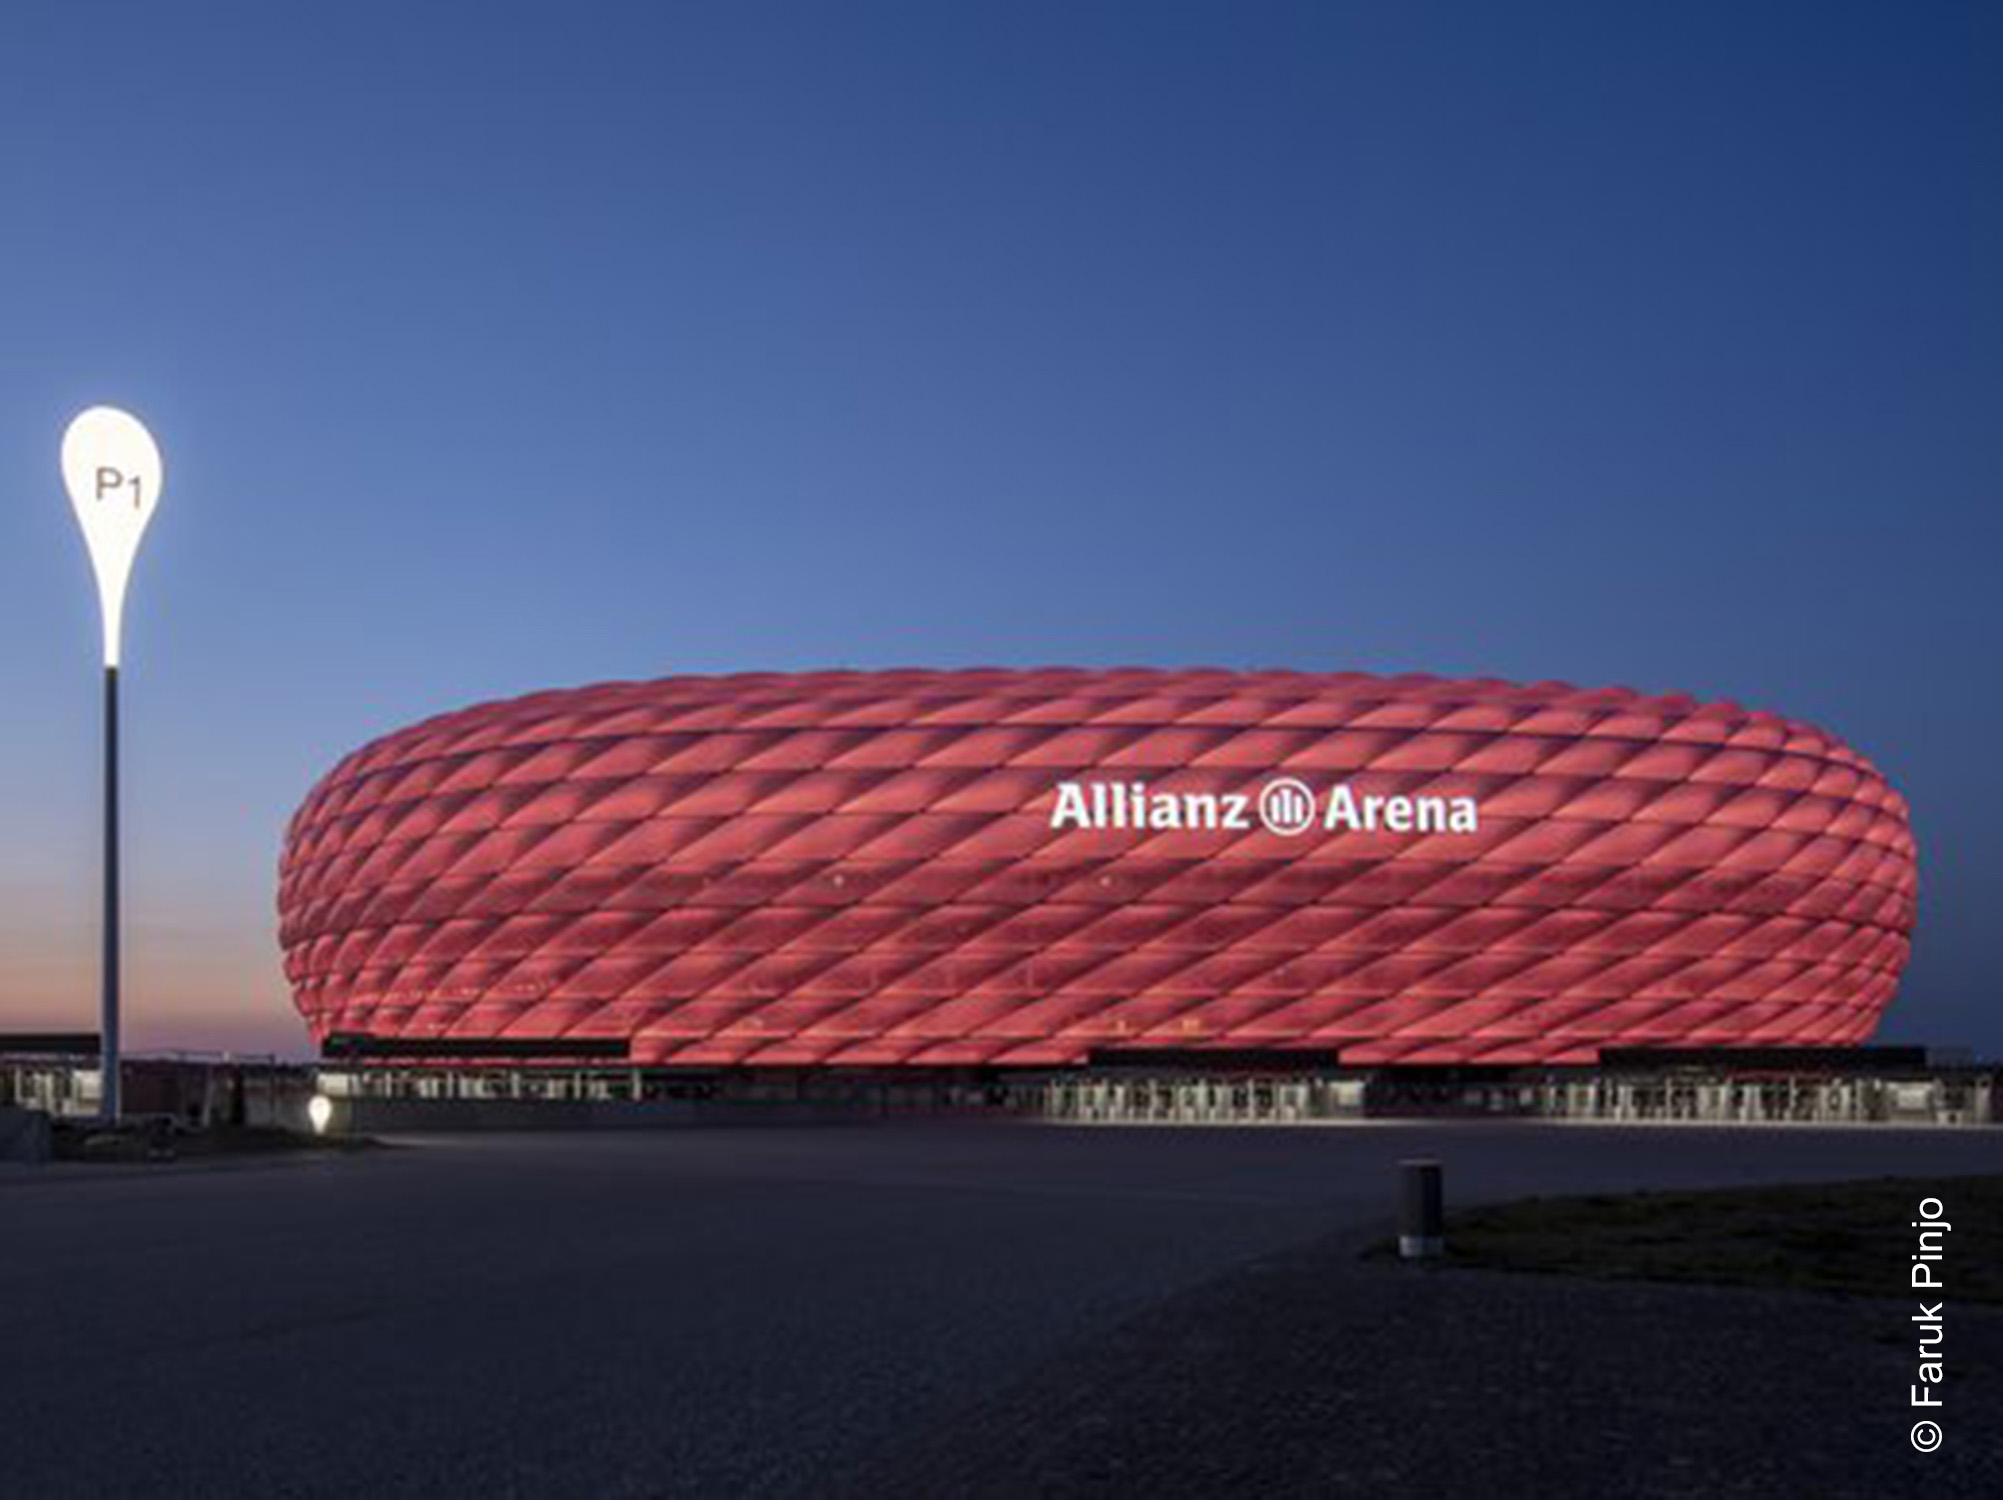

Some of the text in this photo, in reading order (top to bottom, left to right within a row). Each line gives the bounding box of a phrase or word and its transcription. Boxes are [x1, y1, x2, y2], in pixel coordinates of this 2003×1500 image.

[95, 466, 141, 510] P1
[1050, 782, 1478, 833] Allianz Arena
